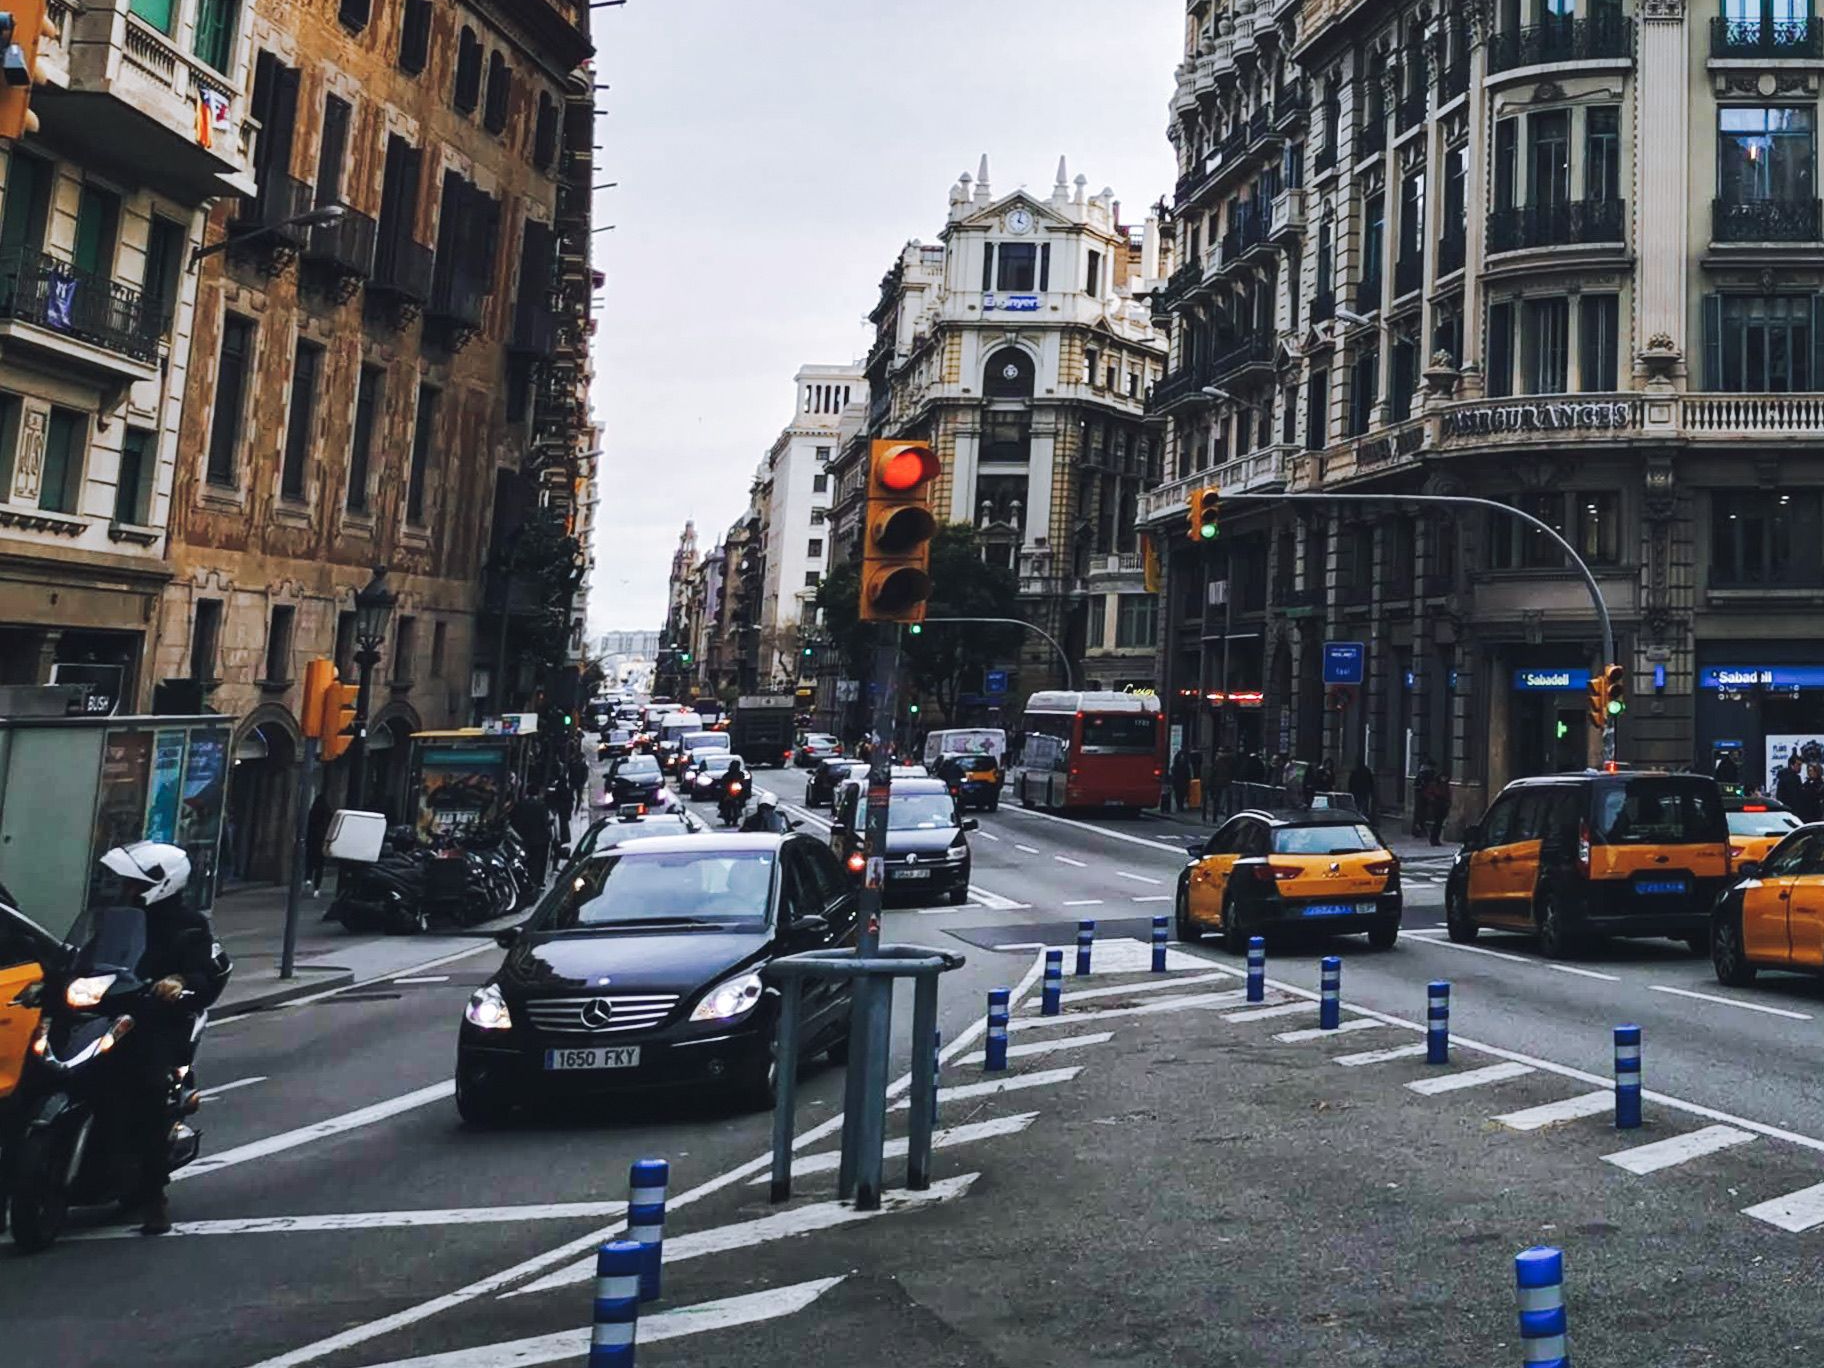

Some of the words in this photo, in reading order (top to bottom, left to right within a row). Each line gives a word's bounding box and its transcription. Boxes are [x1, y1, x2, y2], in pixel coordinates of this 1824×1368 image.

[1526, 673, 1570, 686] Sabadell
[559, 1050, 596, 1068] 1650
[604, 1048, 636, 1066] FKY
